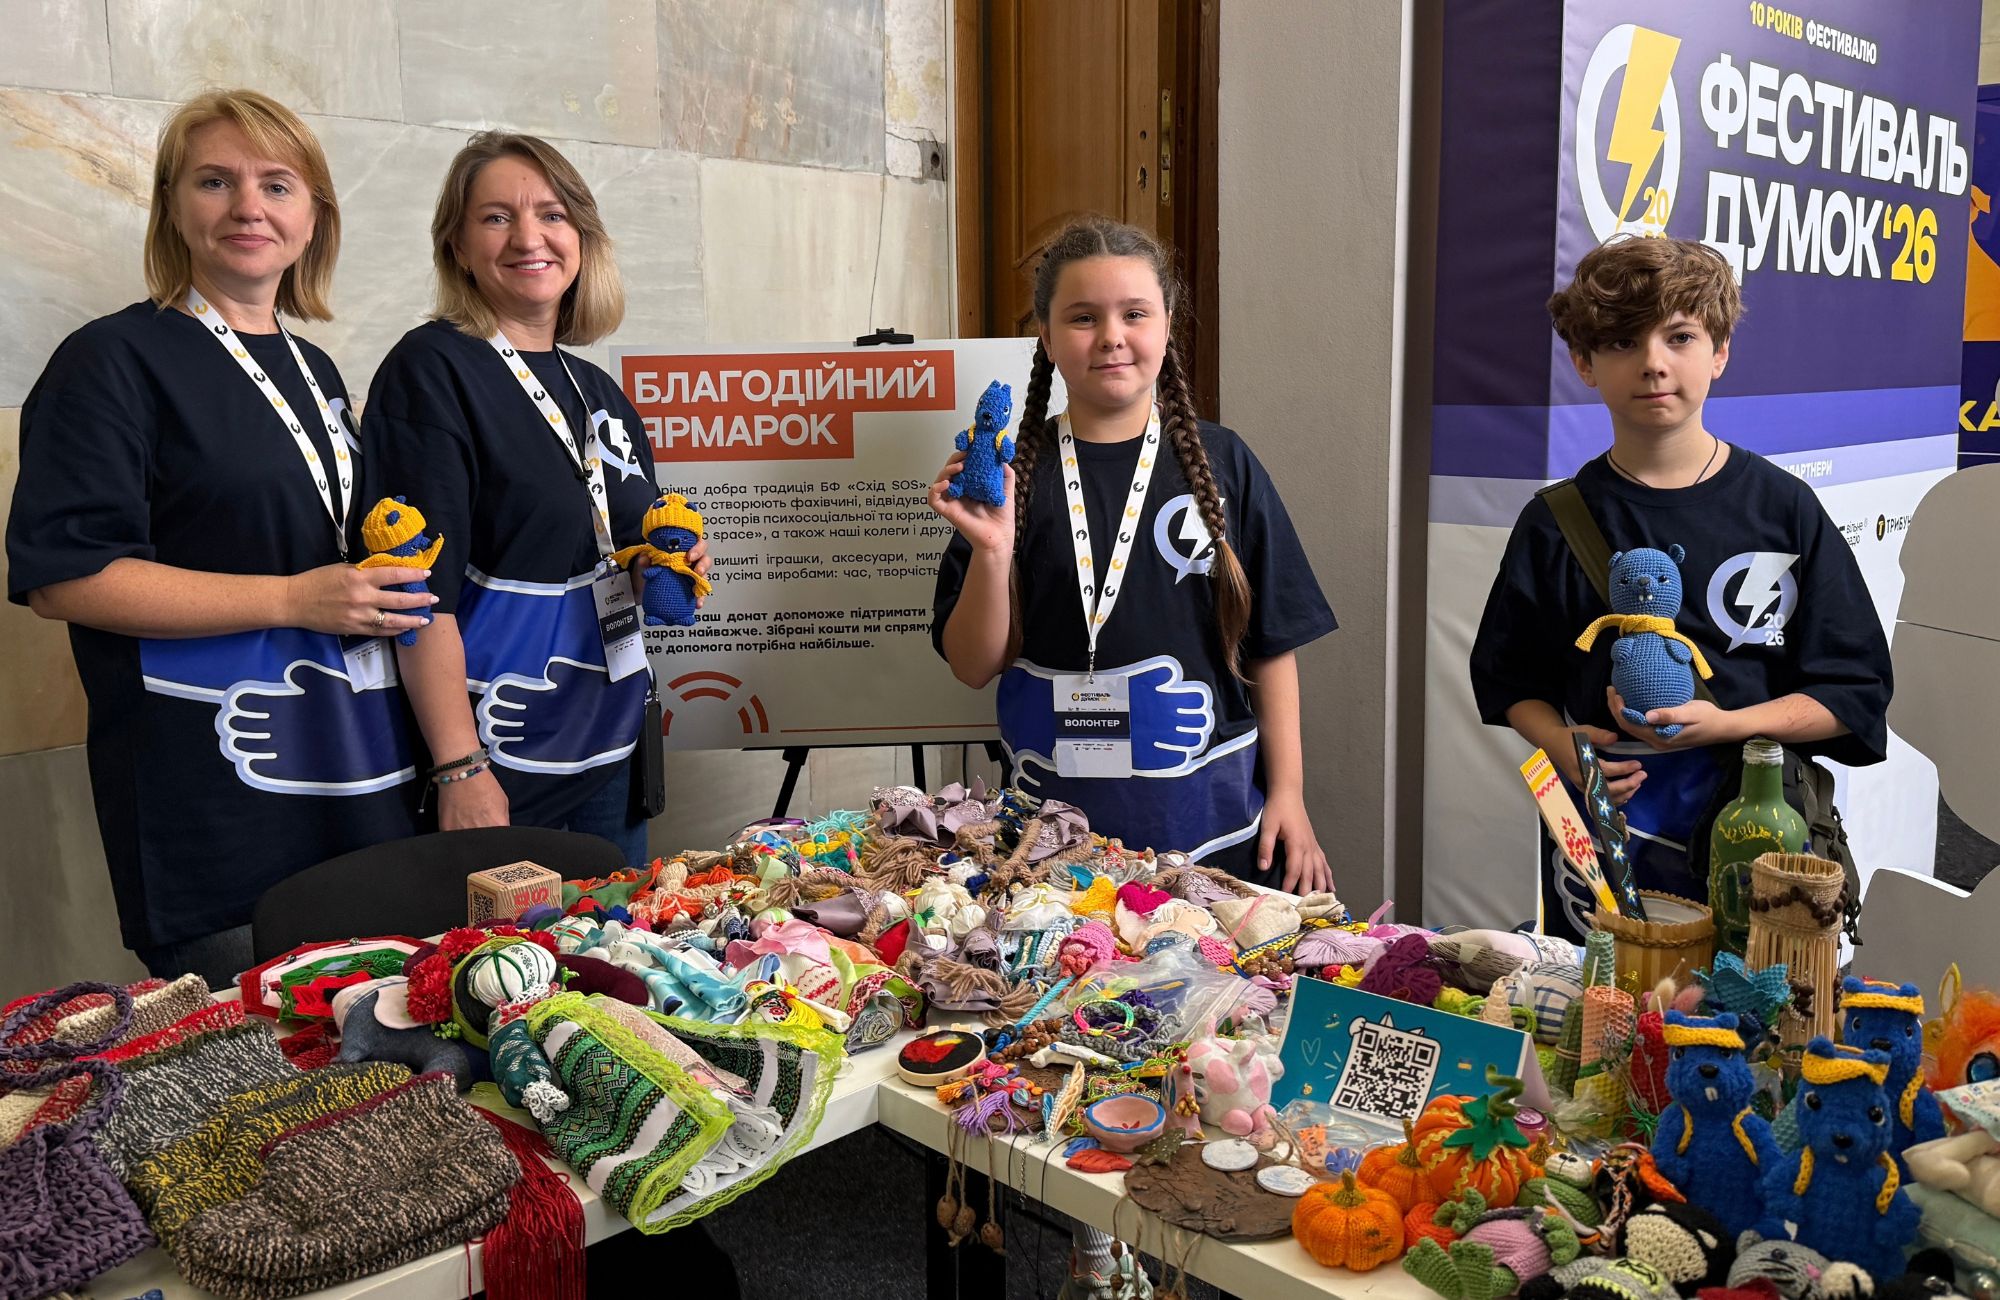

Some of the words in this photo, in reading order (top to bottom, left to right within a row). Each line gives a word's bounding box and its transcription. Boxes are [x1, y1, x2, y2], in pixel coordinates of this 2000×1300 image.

[1750, 1, 1765, 27] 10
[1766, 6, 1803, 40] РОКІВ
[1806, 19, 1877, 65] ФЕСТИВАЛЮ
[1700, 53, 1968, 196] ФЕСТИВАЛЬ
[1643, 186, 1669, 226] 20
[1700, 171, 1883, 286] ДУМОК
[634, 359, 936, 407] БЛАГОДІЙНИЙ
[642, 413, 839, 449] ЯРМАРОК
[660, 484, 697, 496] річна
[703, 483, 747, 497] добра
[753, 481, 814, 496] традиція
[820, 481, 841, 492] БФ
[847, 480, 886, 493] «Схід
[710, 499, 787, 511] створюють
[790, 495, 862, 511] фахівчині,
[865, 494, 928, 509] відвідува
[702, 512, 761, 527] росторів
[763, 510, 876, 524] психосоціальної
[879, 512, 893, 521] та
[896, 511, 942, 523] юриди
[713, 530, 767, 543] space»,
[771, 530, 780, 539] а
[783, 528, 825, 538] також
[829, 525, 860, 537] наші
[864, 527, 909, 537] колеги
[913, 524, 917, 535] і
[713, 554, 759, 566] вишиті
[766, 553, 824, 567] іграшки,
[831, 552, 908, 565] аксесуари,
[726, 569, 762, 583] усіма
[767, 568, 838, 582] виробами:
[843, 568, 871, 579] час,
[877, 565, 940, 580] творчість
[606, 614, 634, 632] ВОЛОНТЕР
[694, 612, 721, 622] ваш
[727, 612, 768, 623] донат
[773, 610, 845, 622] допоможе
[850, 607, 926, 620] підтримати
[1763, 613, 1786, 630] 20
[644, 629, 685, 641] зараз
[688, 626, 762, 638] найважче.
[766, 623, 815, 638] Зібрані
[818, 624, 860, 634] кошти
[864, 624, 881, 633] ми
[884, 622, 933, 635] спряму
[1764, 630, 1785, 646] 26
[645, 645, 662, 655] де
[665, 643, 732, 655] допомога
[736, 639, 796, 653] потрібна
[799, 638, 875, 650] найбільше.
[1064, 719, 1120, 728] ВОЛОНТЕР
